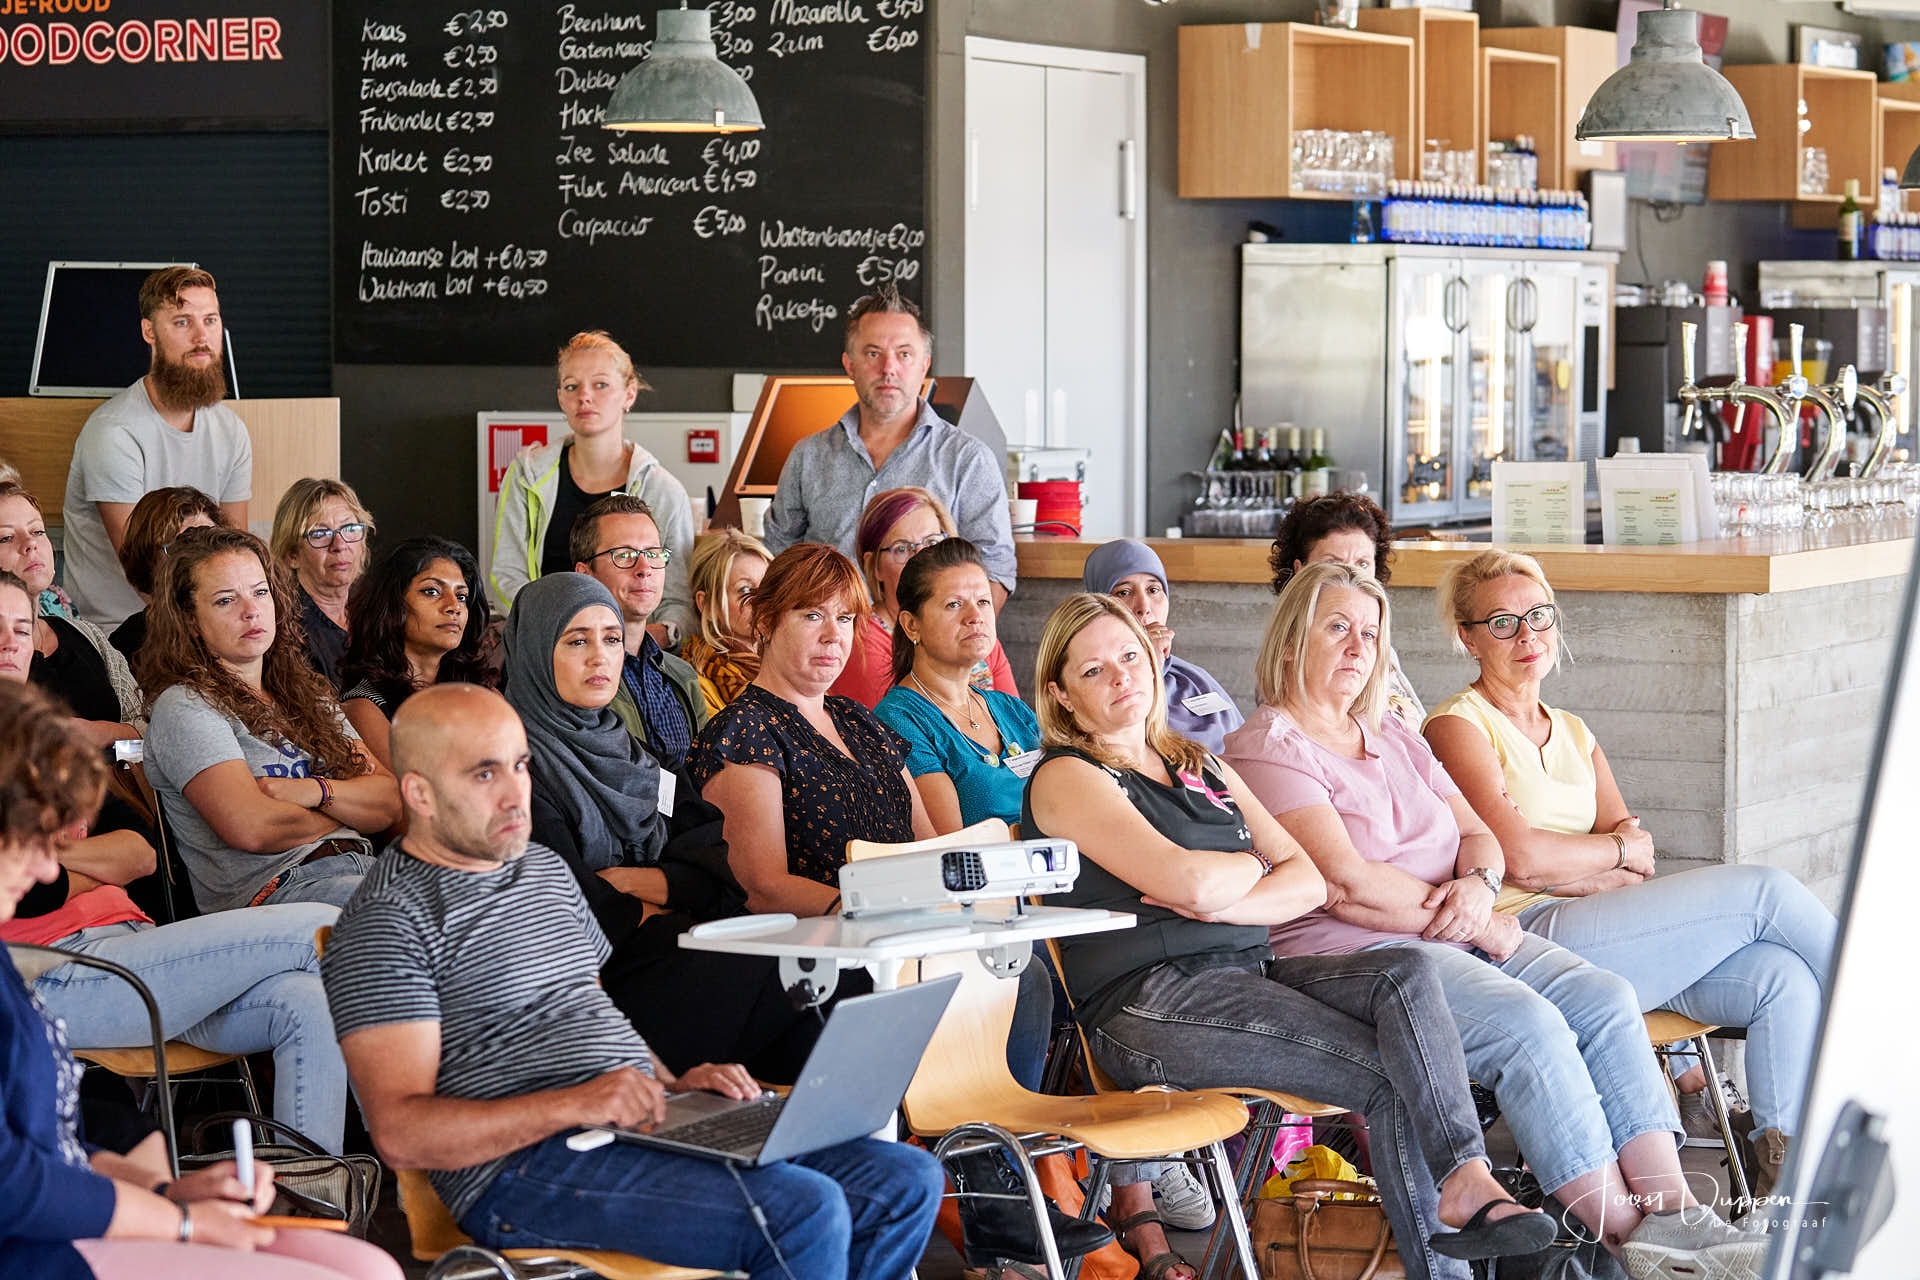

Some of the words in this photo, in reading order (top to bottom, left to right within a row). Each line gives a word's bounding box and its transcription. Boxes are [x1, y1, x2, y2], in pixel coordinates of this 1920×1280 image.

[556, 4, 647, 35] Beenham
[769, 0, 870, 25] Mozarella
[0, 17, 283, 65] ODCORNER
[361, 17, 407, 43] Kaas
[767, 31, 824, 58] Zalm
[866, 25, 919, 53] €6,00
[361, 48, 408, 72] Ham
[360, 78, 446, 102] Eiersalade
[359, 106, 444, 134] Frikandel
[358, 143, 428, 176] Kroket
[555, 135, 596, 164] Zee
[354, 186, 408, 216] Tosti
[558, 173, 608, 204] Filet
[617, 171, 701, 196] American
[558, 208, 653, 246] Carpaccio
[693, 205, 747, 238] €5,00
[361, 240, 444, 270] Italiaanse
[450, 240, 480, 270] bol
[445, 272, 474, 297] bol
[758, 254, 825, 290] Panini
